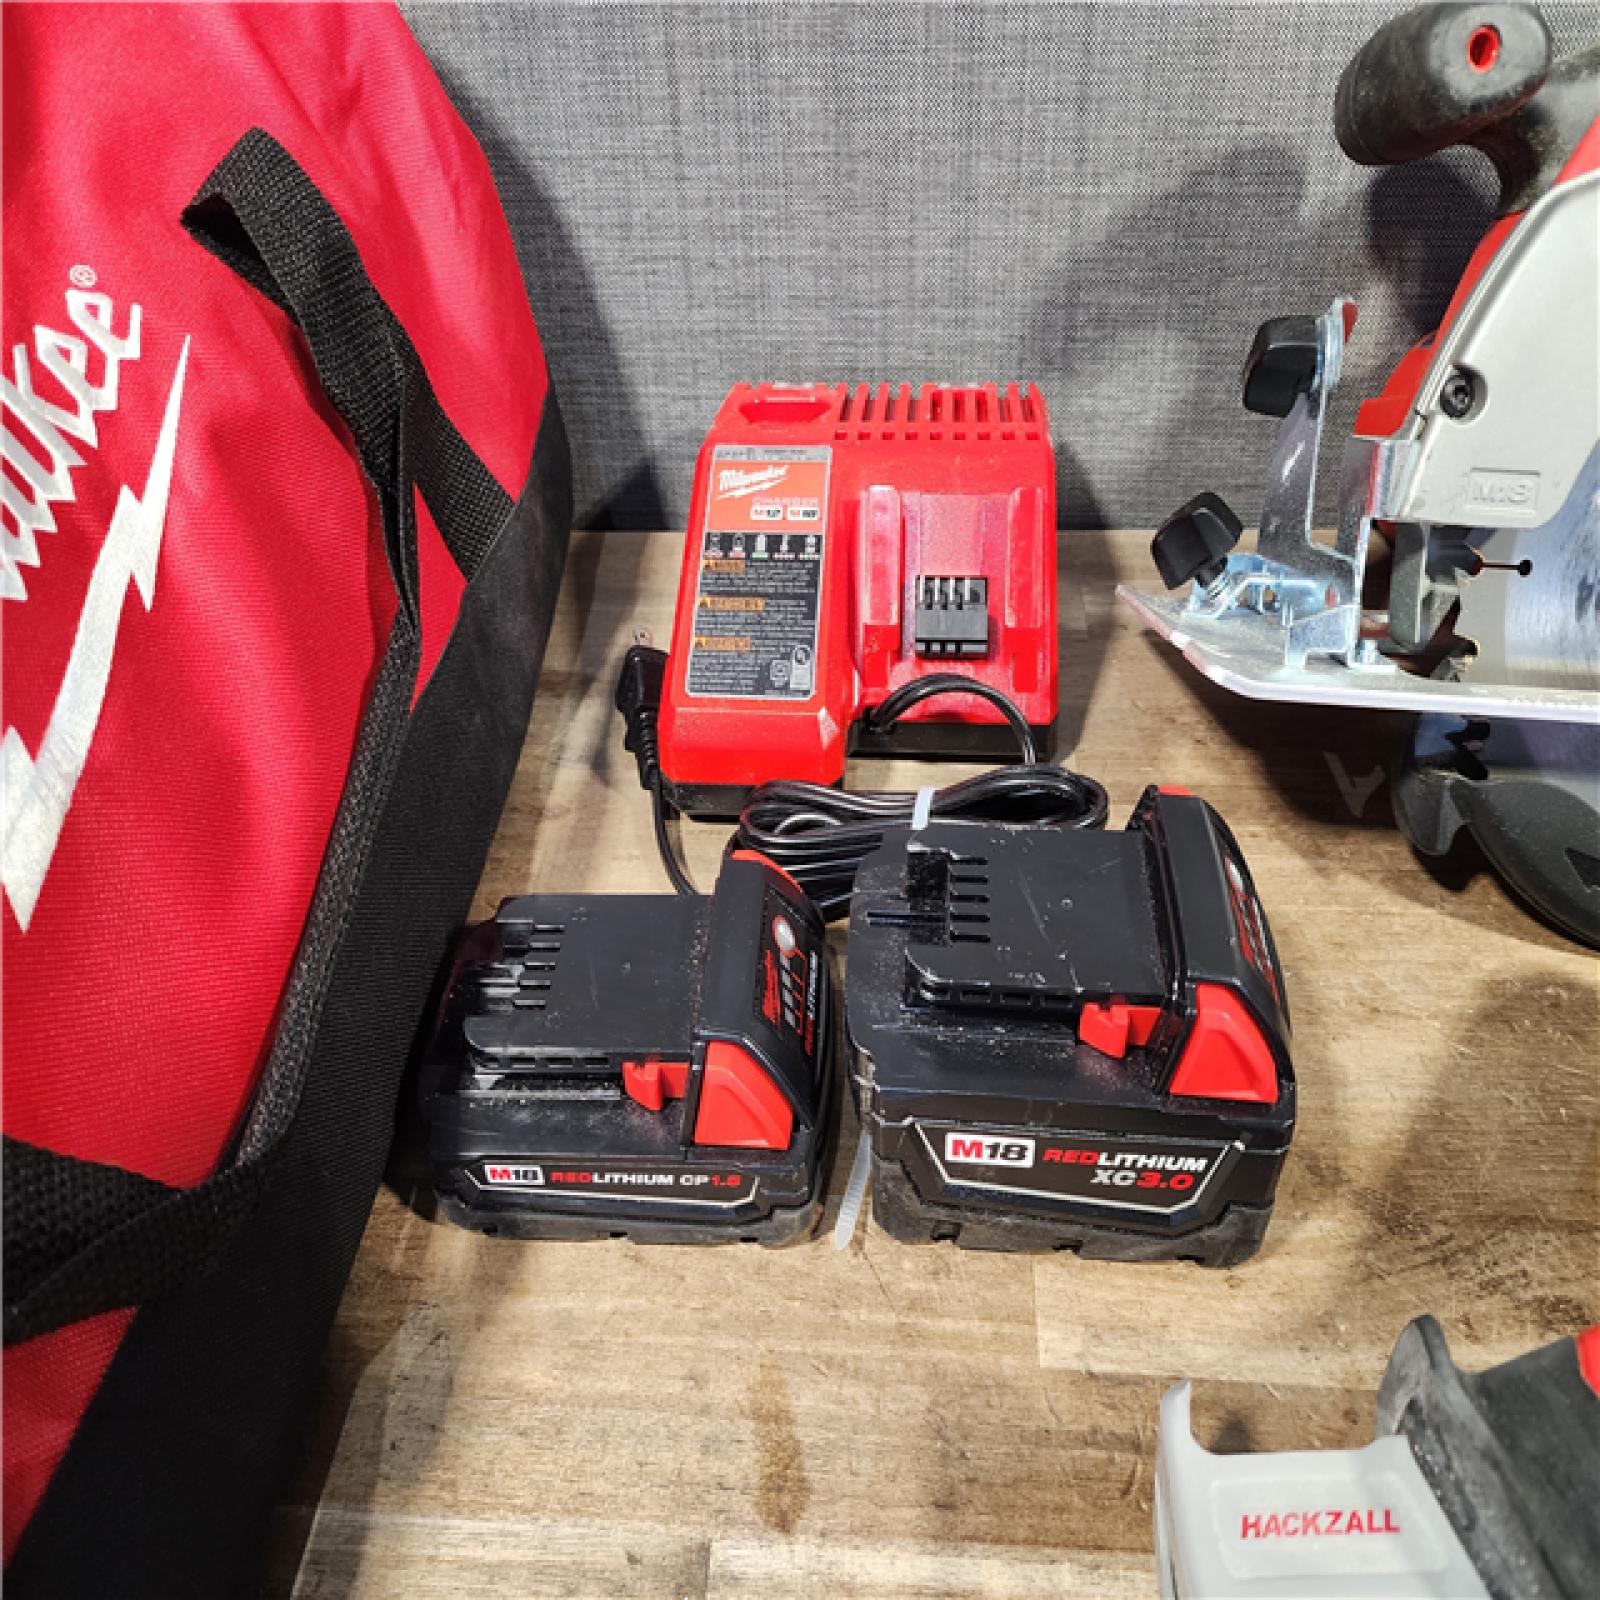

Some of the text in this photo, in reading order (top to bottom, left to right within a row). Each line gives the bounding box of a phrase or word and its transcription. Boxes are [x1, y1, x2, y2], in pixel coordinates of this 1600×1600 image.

[951, 1139, 1207, 1171] M18 REDLITHIUM
[489, 1168, 539, 1181] M18
[551, 1171, 673, 1185] REDLITHIUM
[1090, 1169, 1194, 1190] XC3.0
[1240, 1508, 1400, 1540] HACKZALL
